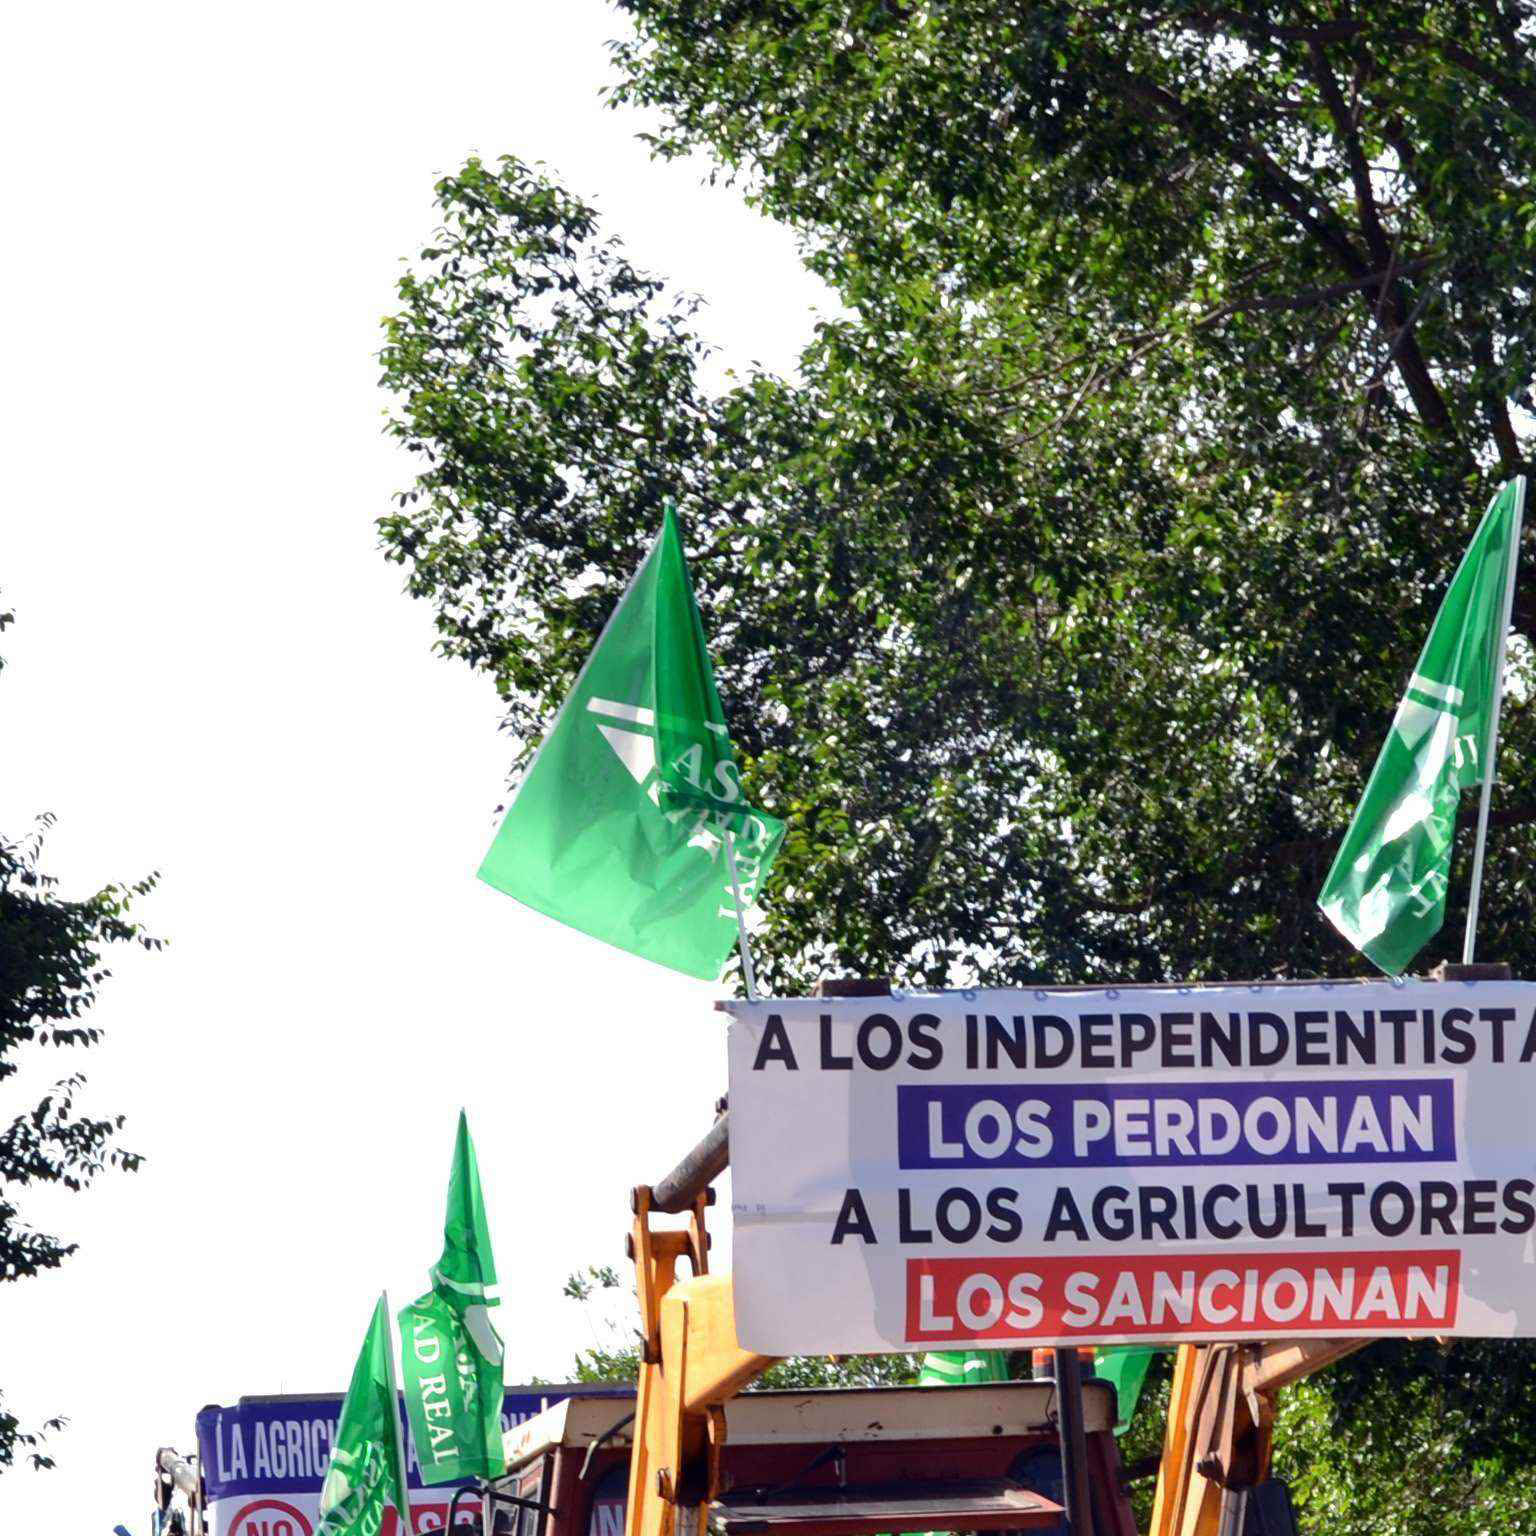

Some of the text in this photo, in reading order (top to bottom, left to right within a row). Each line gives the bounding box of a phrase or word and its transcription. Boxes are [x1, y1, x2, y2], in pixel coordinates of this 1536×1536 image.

[751, 1013, 800, 1071] A
[819, 1012, 945, 1071] LOS
[927, 1094, 1435, 1160] LOS PERDONAN
[829, 1178, 1536, 1245] A LOS AGRICULTORES
[918, 1264, 1450, 1332] LOS SANCIONAN
[215, 1413, 249, 1483] LA
[419, 1372, 461, 1467] REAL
